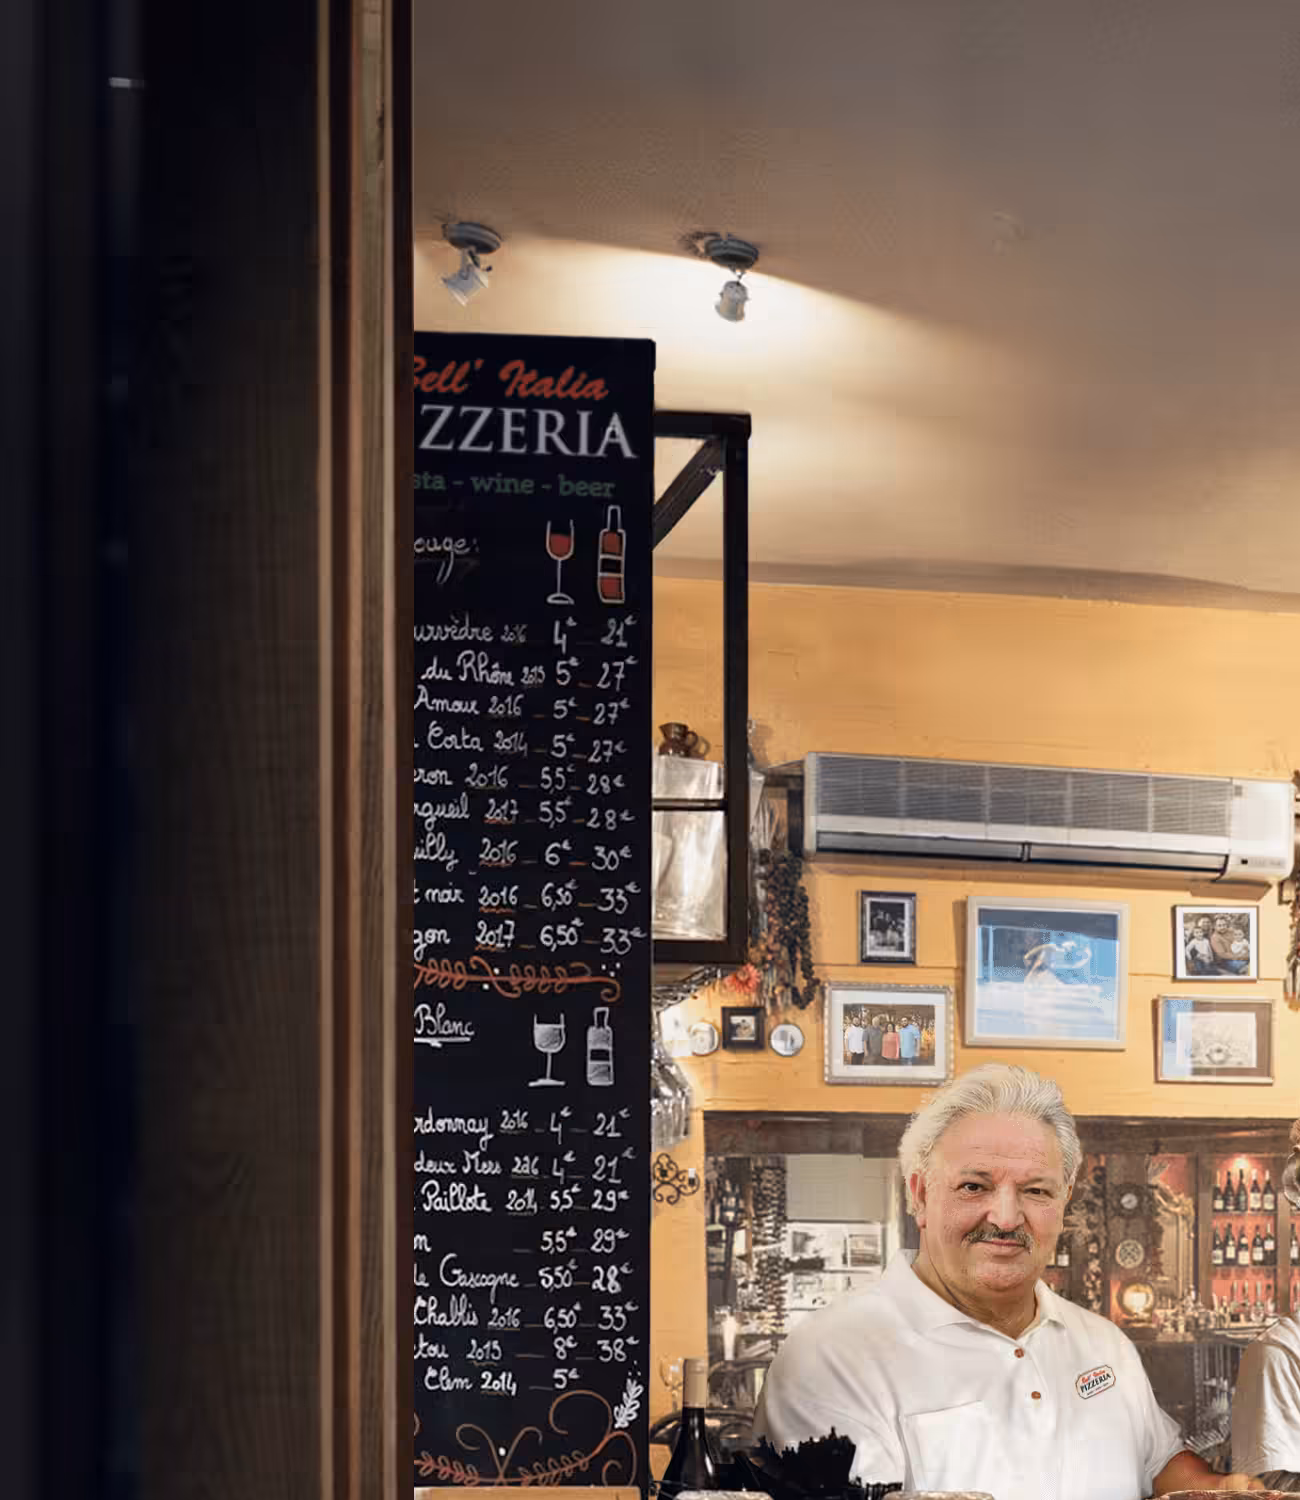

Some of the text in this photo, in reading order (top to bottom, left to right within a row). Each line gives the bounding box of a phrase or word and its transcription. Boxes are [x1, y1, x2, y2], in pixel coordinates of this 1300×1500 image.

[499, 360, 609, 400] Italia
[419, 404, 638, 459] ZZERIA
[470, 472, 535, 495] wine
[558, 474, 616, 497] beer
[420, 655, 453, 680] du
[455, 649, 515, 687] Rhône
[487, 694, 524, 717] 2016
[464, 762, 509, 788] 2016
[479, 837, 519, 864] 2016
[477, 884, 520, 907] 2016
[475, 919, 516, 948] 2017
[414, 1002, 475, 1036] Blanc
[421, 1179, 493, 1213] Paillote
[505, 1187, 538, 1214] 2014
[439, 1252, 520, 1305] Gascogne
[414, 1293, 480, 1327] Chablis
[487, 1307, 522, 1329] 2016
[414, 1331, 450, 1361] tou
[480, 1369, 518, 1397] 2014
